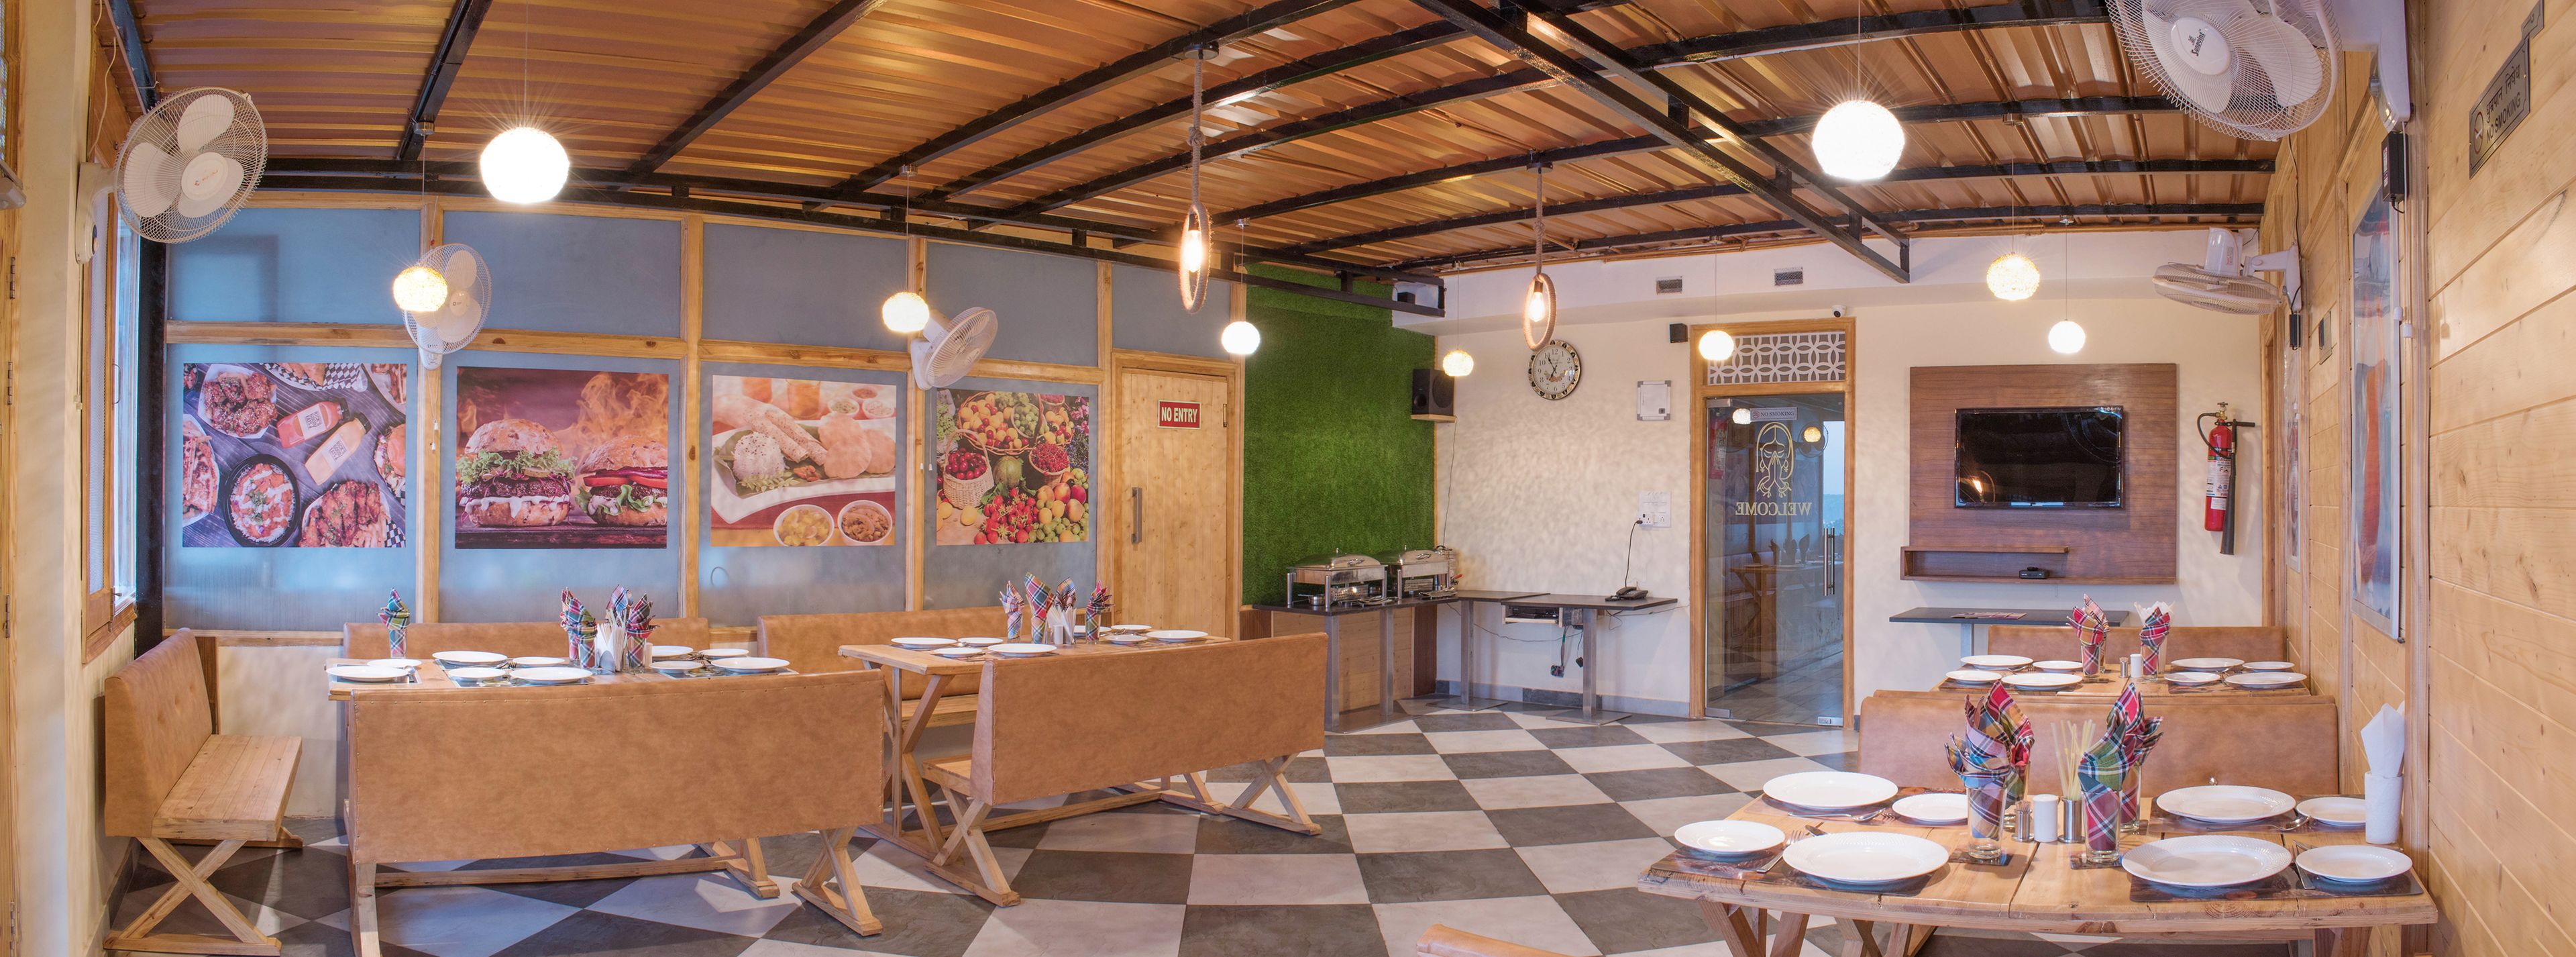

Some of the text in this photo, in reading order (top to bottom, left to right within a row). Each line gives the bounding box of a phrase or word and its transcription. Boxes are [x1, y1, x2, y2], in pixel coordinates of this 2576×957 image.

[2192, 32, 2205, 56] Sunpoint
[2486, 91, 2521, 144] NO SMOKING
[1161, 407, 1197, 423] NO ENTRY
